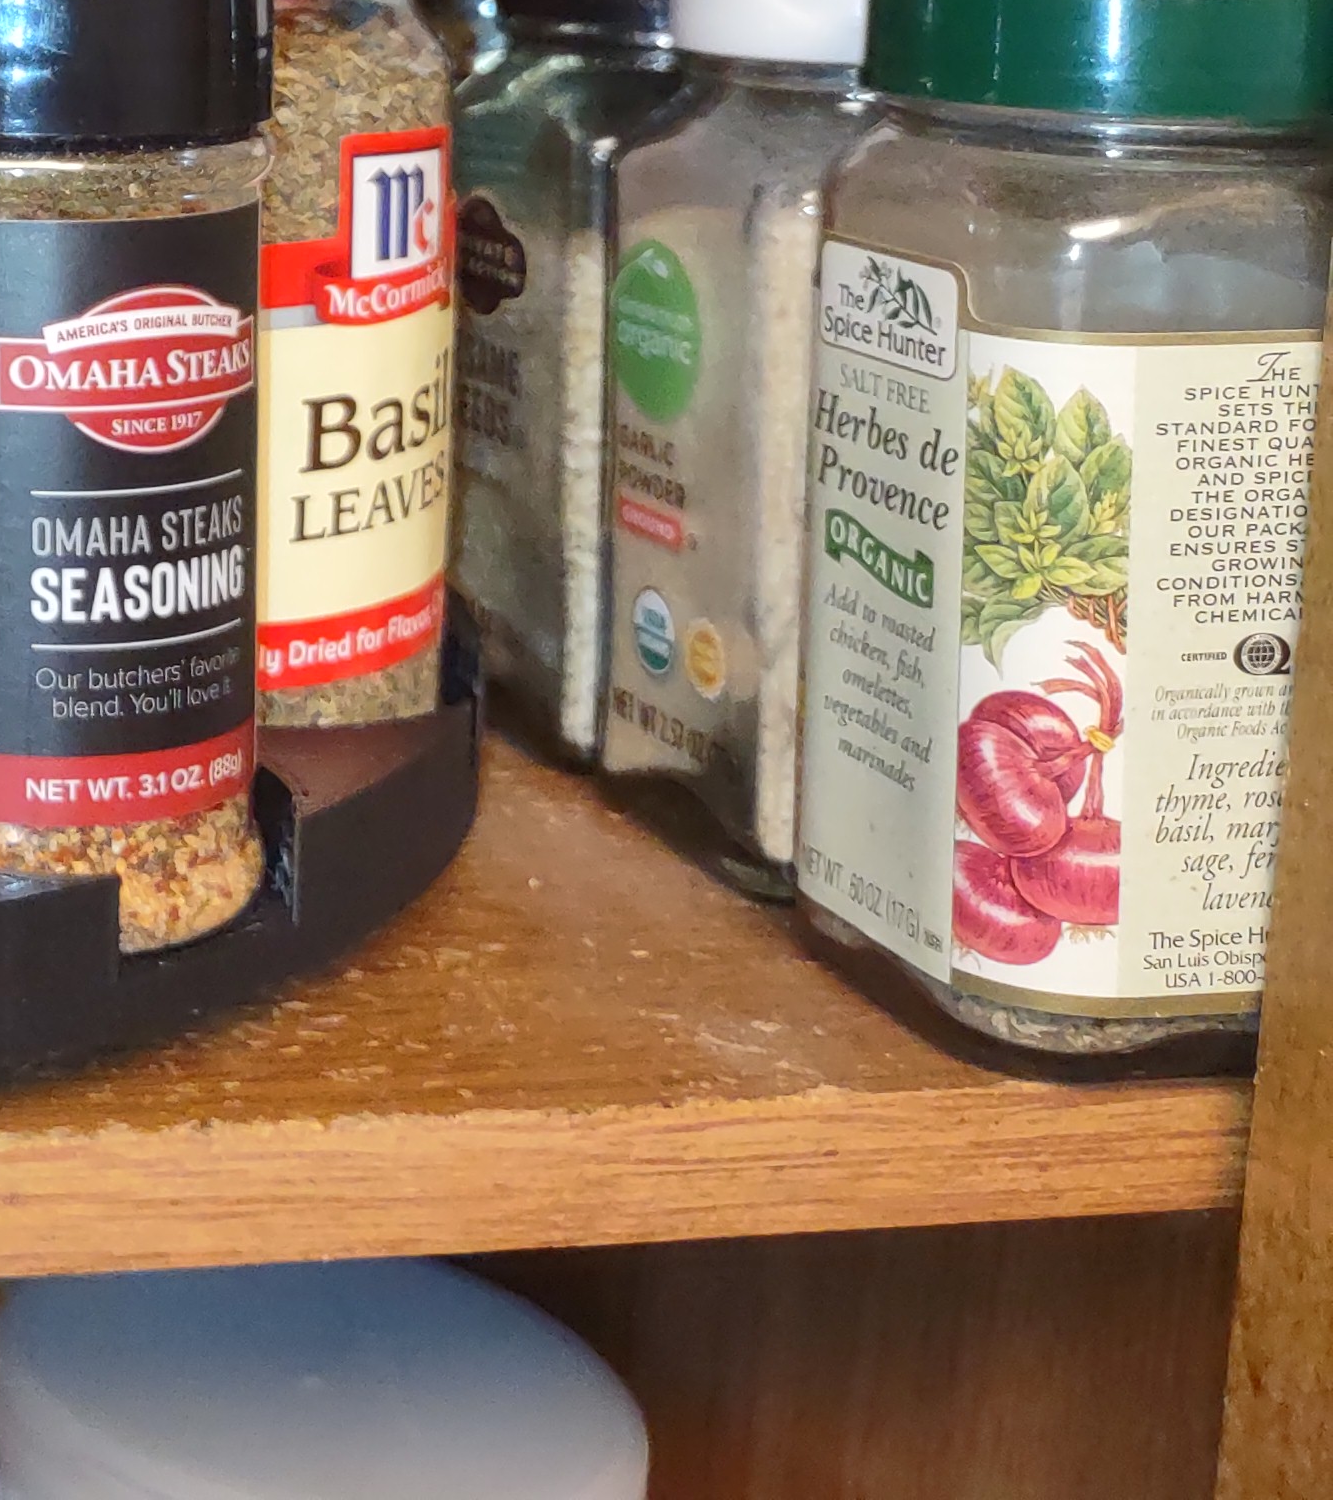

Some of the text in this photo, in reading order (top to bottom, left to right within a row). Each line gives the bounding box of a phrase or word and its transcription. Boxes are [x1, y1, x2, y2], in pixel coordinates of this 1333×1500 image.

[837, 282, 866, 311] The
[56, 312, 233, 345] AMERICA'S ORIGINAL BUTCHER
[823, 304, 947, 369] Spice Hunter
[8, 337, 251, 391] OMAHA STEAKS
[838, 361, 931, 416] SALT FREE
[1183, 383, 1320, 402] SPICE HUNT
[111, 411, 204, 437] SINCE 1917
[297, 346, 450, 474] Basil
[1218, 402, 1274, 418] SETS
[814, 387, 960, 478] Herbes de
[1155, 418, 1317, 437] STANDARD FO
[1177, 436, 1315, 454] FINEST QUA
[1175, 454, 1279, 472] ORGANIC
[817, 442, 951, 532] Provence
[1197, 472, 1245, 488] AND
[288, 449, 445, 543] LEAVES
[1191, 487, 1306, 505] THE ORGA
[31, 494, 243, 559] OMAHA STEAKS
[1169, 504, 1309, 523] DESIGNATIO
[1187, 521, 1307, 540] OUR PACK
[829, 514, 932, 601] ORGANIC
[1169, 540, 1276, 557] ENSURES
[1211, 556, 1304, 574] GROWIN
[31, 547, 244, 625] SEASONING
[1173, 591, 1235, 608] FROM
[1194, 607, 1303, 625] CHEMICA
[287, 630, 351, 668] Dried
[356, 626, 383, 653] for
[35, 666, 83, 690] Our
[88, 658, 186, 690] butchers'
[52, 681, 221, 719] blend. You'll love
[1154, 683, 1276, 706] Organically grown
[1176, 721, 1229, 743] Organic
[25, 776, 82, 802] NET
[87, 775, 133, 800] WT.
[137, 771, 167, 798] 3.1
[170, 763, 206, 791] OZ.
[1185, 749, 1286, 790] Ingredie
[1154, 784, 1232, 817] thyme,
[1154, 814, 1215, 844] basil,
[1180, 852, 1235, 882] sage,
[1201, 882, 1274, 912] laven
[1148, 928, 1244, 951] The Spice
[1142, 947, 1267, 970] San Luis Obisp
[1164, 971, 1202, 989] USA
